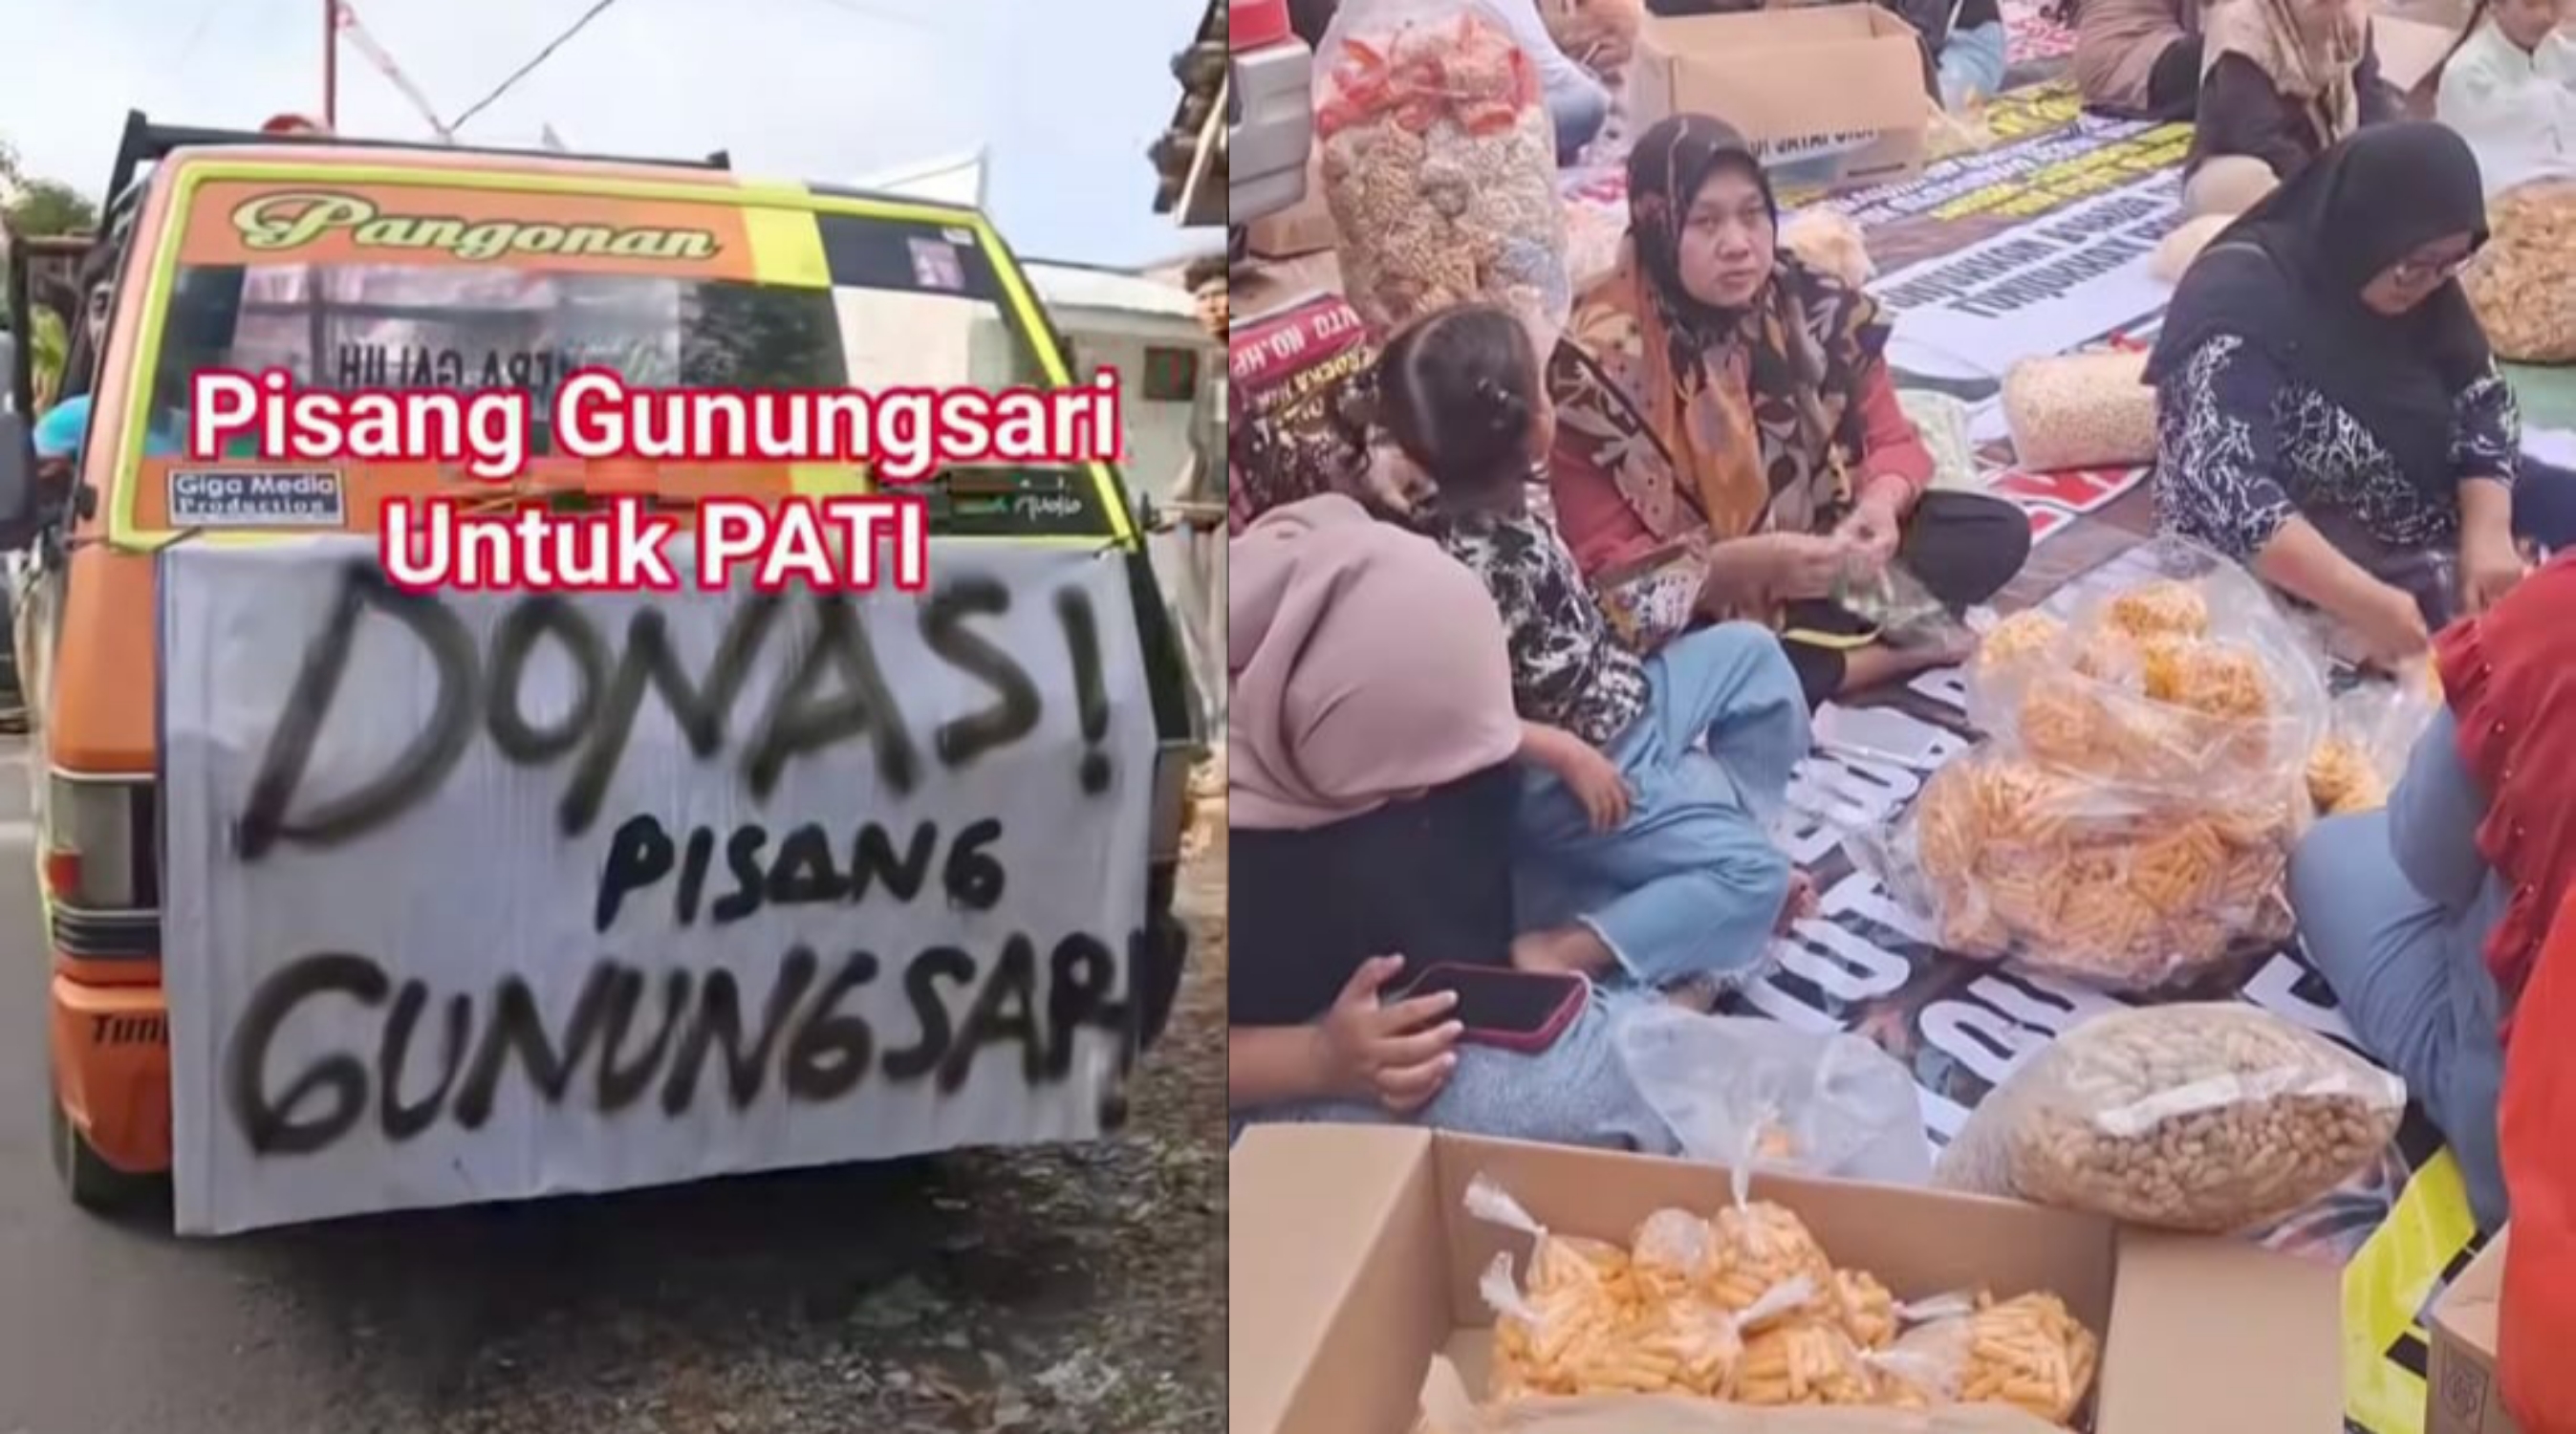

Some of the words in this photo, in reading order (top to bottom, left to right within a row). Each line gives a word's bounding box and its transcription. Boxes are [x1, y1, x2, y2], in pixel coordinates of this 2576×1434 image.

[229, 190, 720, 260] Pangonan
[176, 474, 243, 498] Giga
[250, 474, 335, 494] Media
[178, 496, 325, 513] Production
[595, 814, 1007, 934] PISANG
